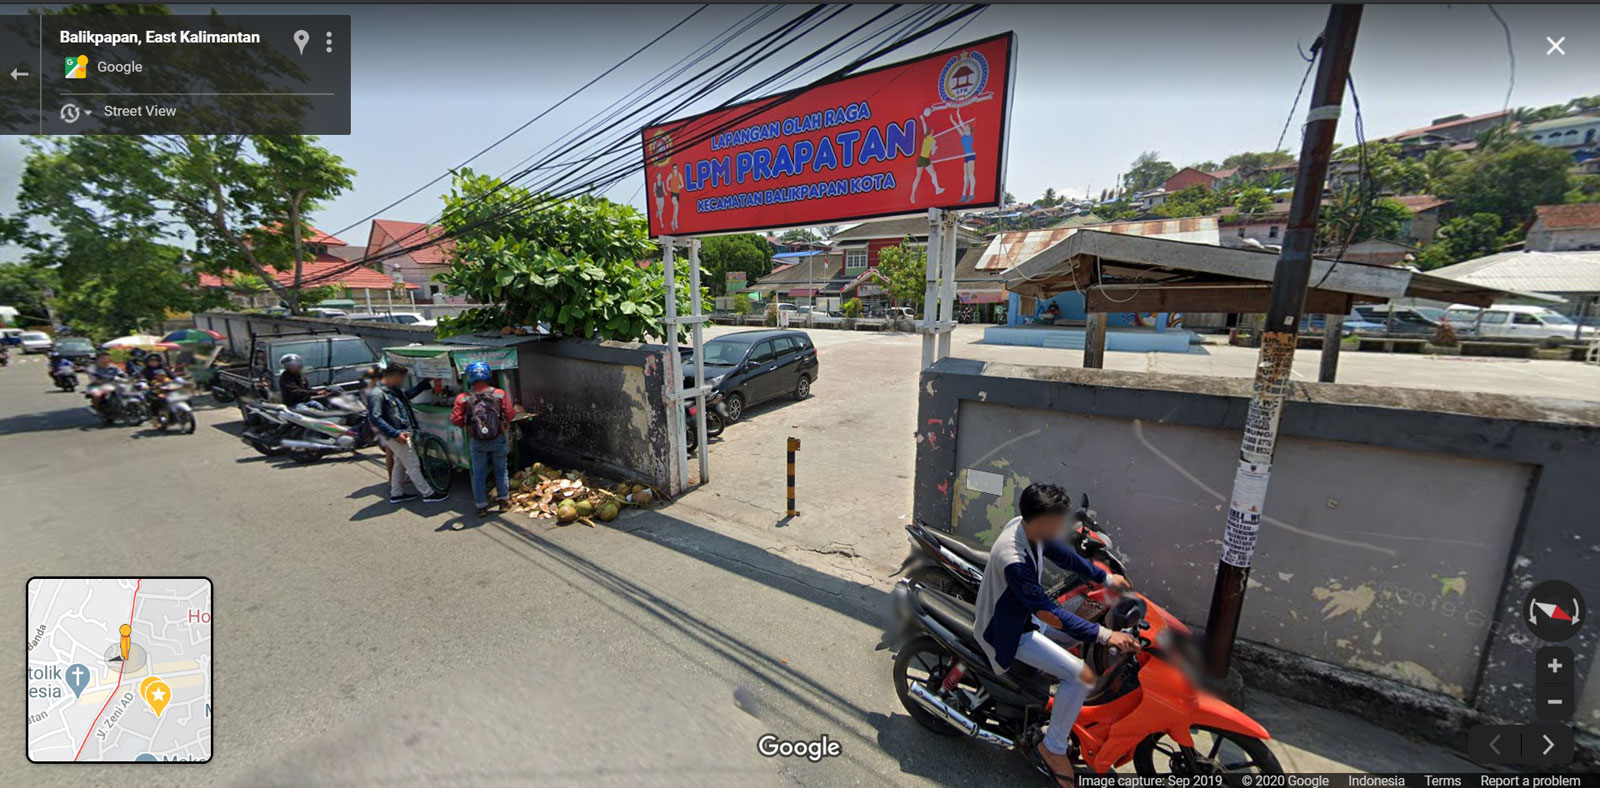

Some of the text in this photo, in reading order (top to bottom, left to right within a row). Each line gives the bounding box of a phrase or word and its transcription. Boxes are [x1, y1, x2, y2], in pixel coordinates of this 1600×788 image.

[711, 101, 871, 151] LAPANGAN OLAH RAGA
[684, 119, 917, 192] LPM PRAPATAN
[697, 172, 897, 213] KECAMATAN BALIKPAPAN KOTA
